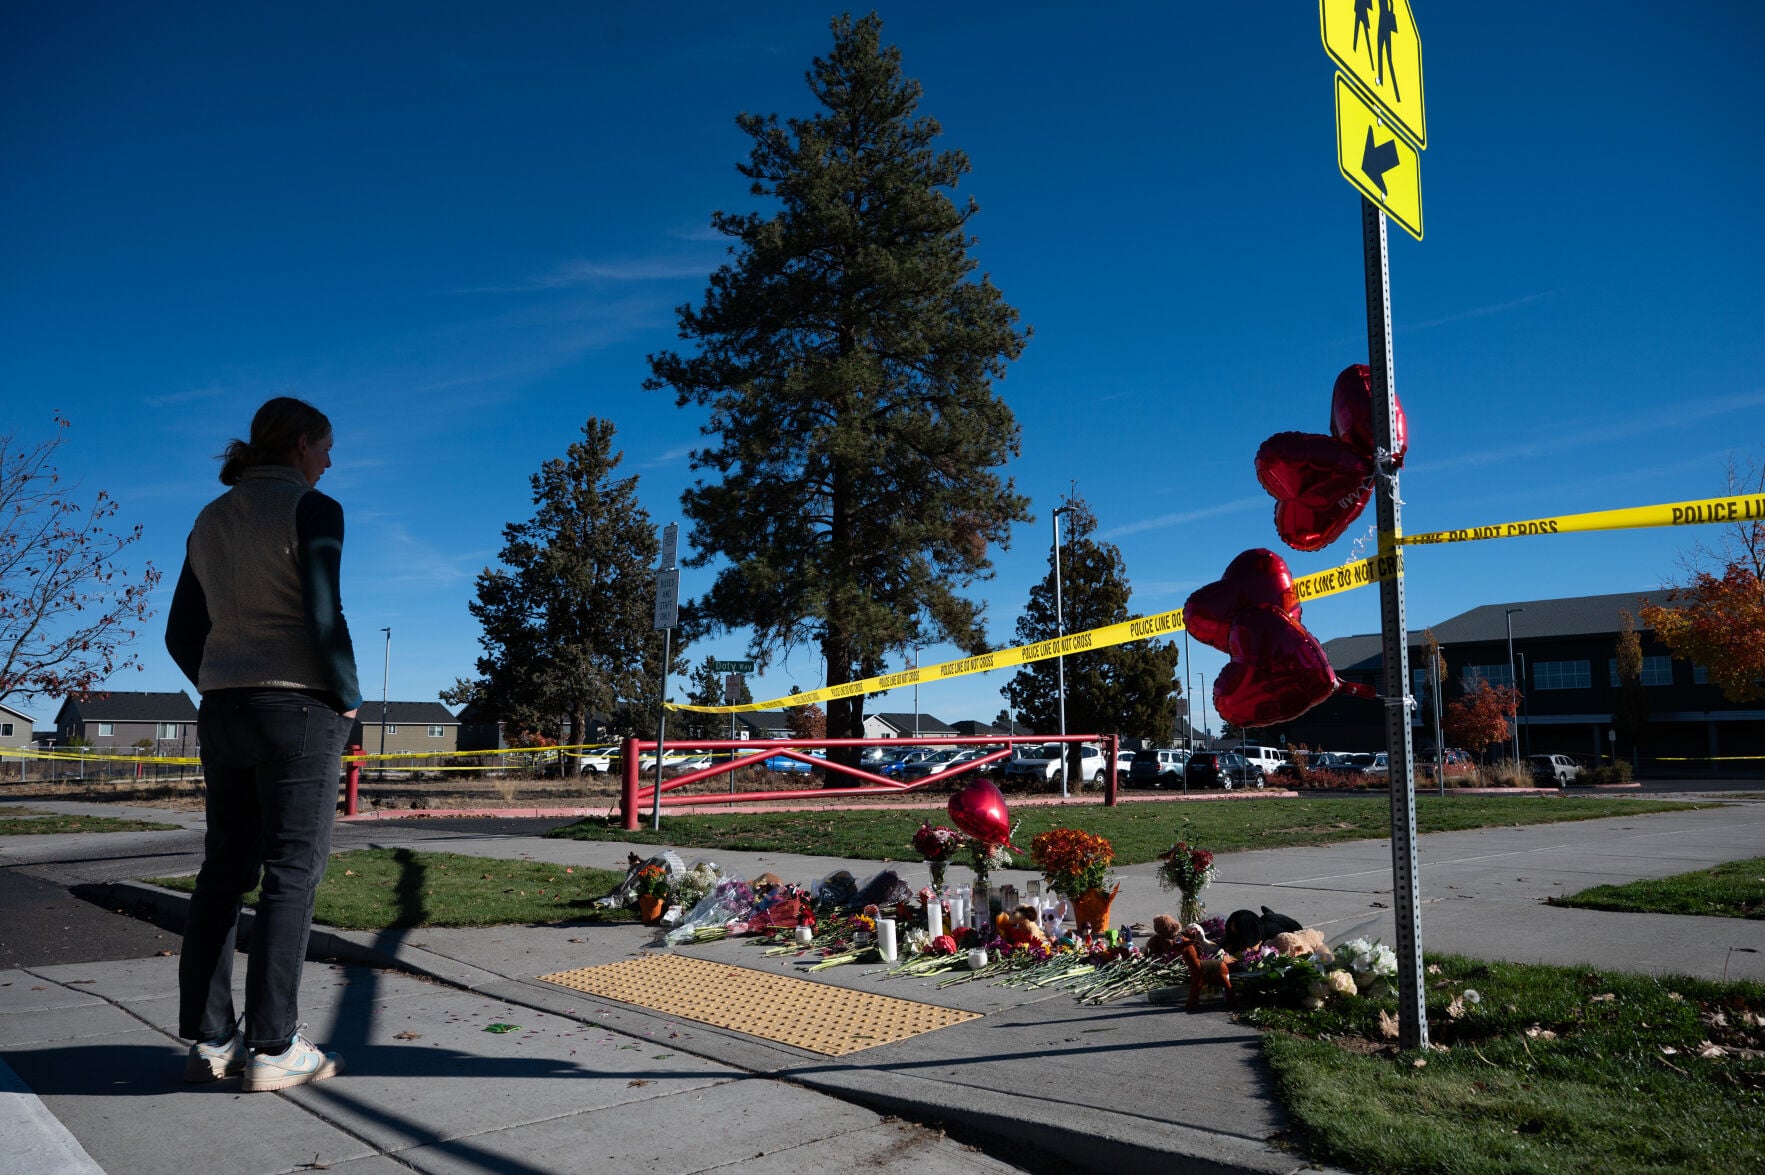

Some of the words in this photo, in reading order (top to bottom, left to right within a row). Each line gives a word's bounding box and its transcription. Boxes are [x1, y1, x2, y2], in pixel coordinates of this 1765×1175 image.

[1672, 502, 1738, 524] POLICE
[1744, 498, 1765, 518] LI
[1473, 526, 1502, 540] NOT
[1507, 520, 1558, 536] CROSS
[1314, 573, 1335, 594] LINE
[1337, 569, 1351, 588] DO
[1354, 561, 1375, 583] NOT
[1130, 619, 1154, 637] POLICE
[1155, 615, 1170, 631] LINE
[1172, 612, 1182, 627] DO
[1022, 645, 1040, 660] POLICE
[1040, 642, 1052, 656] LINE
[1053, 640, 1060, 653] DO
[1061, 638, 1072, 651] NOT
[1073, 633, 1092, 649] CROSS
[716, 661, 737, 672] Doty
[941, 664, 954, 676] POLICE
